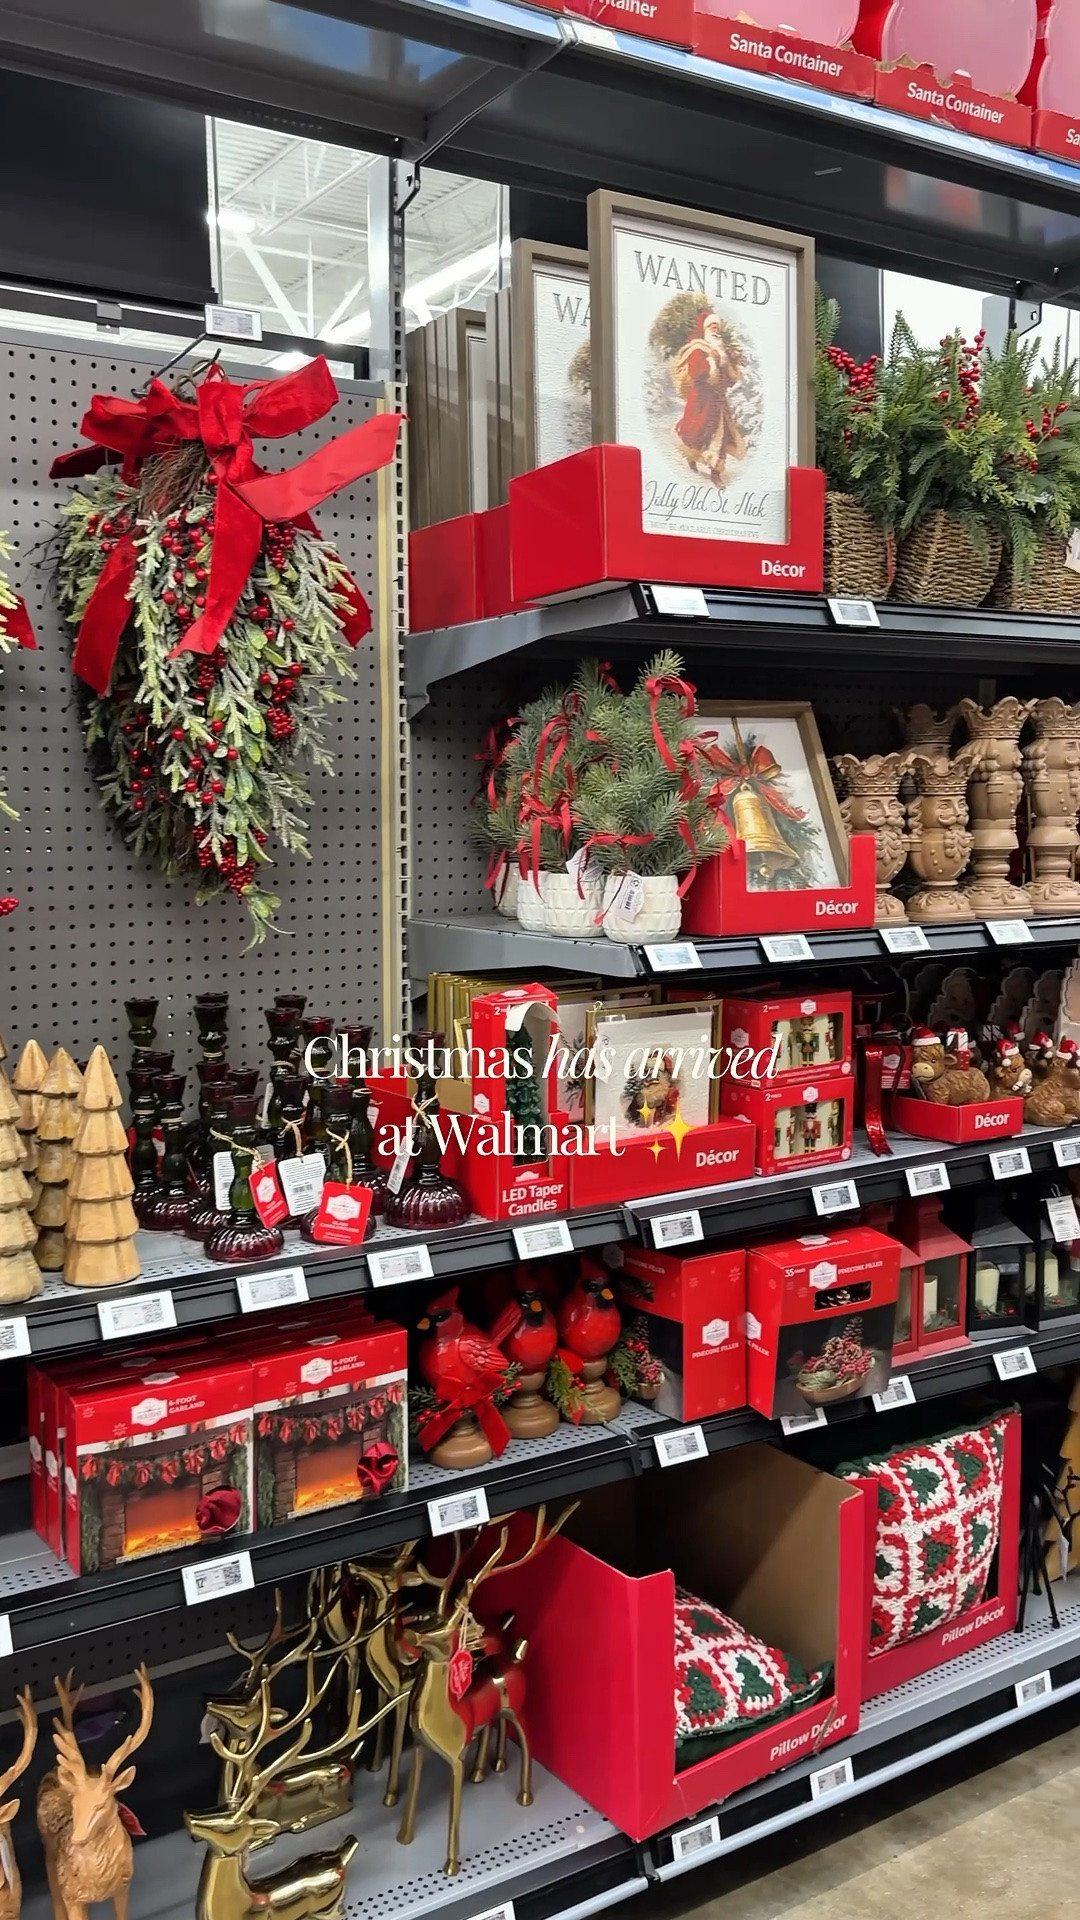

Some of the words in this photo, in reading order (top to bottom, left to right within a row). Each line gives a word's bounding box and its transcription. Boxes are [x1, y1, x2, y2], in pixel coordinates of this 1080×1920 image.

[730, 32, 772, 60] Santa
[773, 44, 844, 77] Container
[906, 81, 945, 107] Santa
[945, 93, 1005, 125] Container
[633, 250, 772, 307] WANTED
[682, 484, 713, 513] Old
[710, 488, 731, 516] St.
[733, 492, 772, 519] Nick
[761, 560, 807, 578] Décor
[814, 900, 859, 918] Décor
[974, 1109, 1010, 1130] Décor
[695, 1147, 739, 1169] Décor
[502, 1188, 527, 1204] LED
[528, 1182, 564, 1202] Taper
[508, 1198, 558, 1218] Candles
[720, 1341, 740, 1353] FILLER
[941, 1620, 975, 1646] Pillow
[974, 1604, 1006, 1630] Décor
[769, 1731, 810, 1762] Pillow
